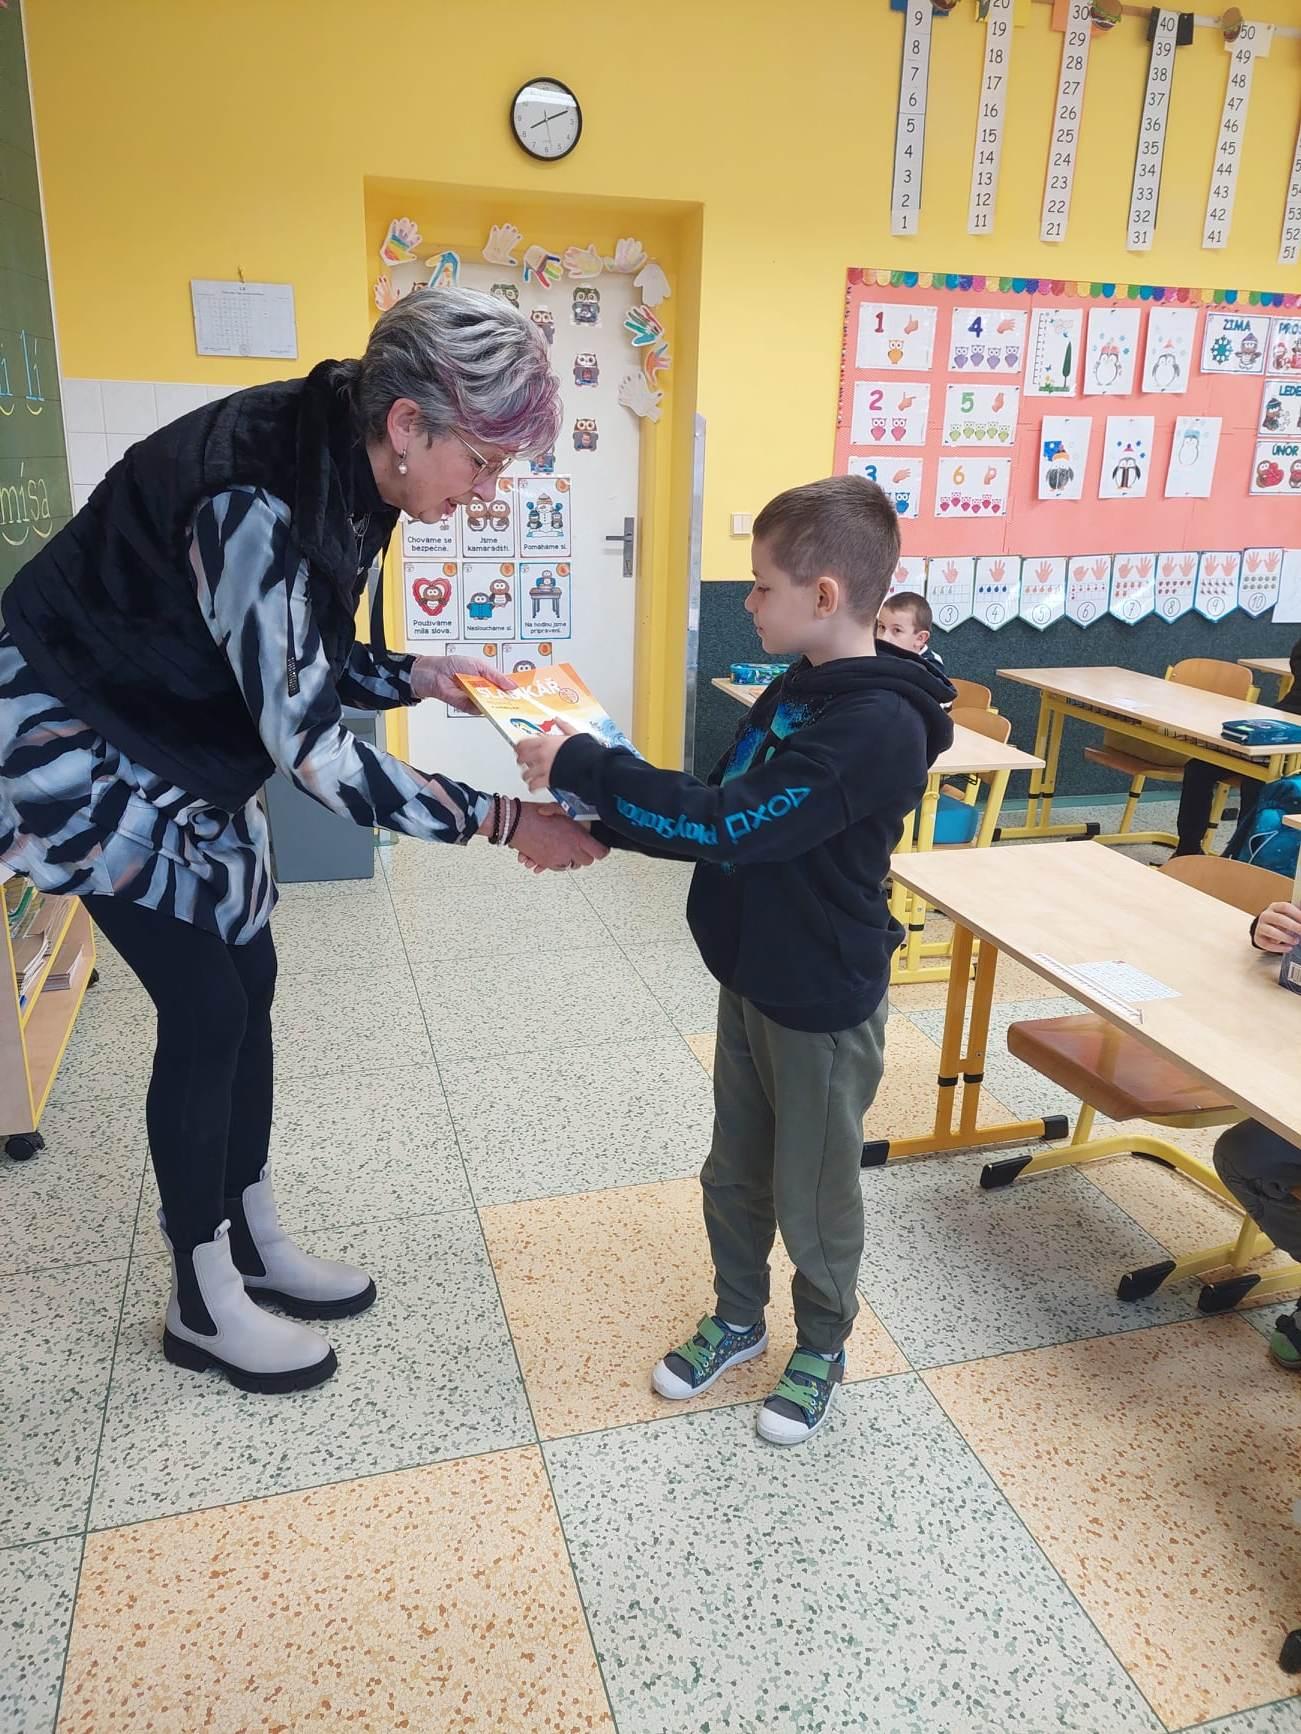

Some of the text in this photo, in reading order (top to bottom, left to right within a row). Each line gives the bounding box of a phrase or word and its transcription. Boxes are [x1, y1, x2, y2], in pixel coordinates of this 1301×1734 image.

[915, 11, 923, 25] 9
[1073, 5, 1089, 20] 30
[991, 22, 1006, 36] 19
[1160, 18, 1174, 32] 40
[1069, 32, 1085, 46] 29
[1240, 25, 1255, 40] 50
[912, 40, 920, 54] 8
[1156, 43, 1171, 56] 39
[989, 49, 1003, 63] 18
[1236, 50, 1251, 63] 49
[1066, 56, 1082, 70] 28
[911, 67, 919, 80] 7
[1152, 68, 1167, 81] 38
[986, 76, 1001, 90] 17
[1231, 75, 1246, 88] 48
[1063, 82, 1079, 95] 27
[909, 93, 917, 106] 6
[1148, 93, 1164, 106] 37
[1228, 98, 1243, 111] 47
[983, 104, 998, 117] 16
[1060, 106, 1076, 120] 26
[907, 119, 915, 132] 5
[1145, 118, 1160, 131] 36
[1224, 119, 1238, 132] 46
[982, 129, 997, 143] 15
[1057, 129, 1073, 142] 25
[905, 145, 912, 158] 4
[1142, 142, 1159, 154] 35
[1220, 142, 1235, 154] 45
[979, 151, 994, 164] 14
[1054, 153, 1071, 166] 24
[1139, 164, 1155, 176] 34
[1217, 163, 1232, 175] 44
[904, 170, 911, 183] 3
[977, 173, 992, 185] 13
[1051, 176, 1067, 189] 23
[1136, 188, 1153, 200] 33
[1213, 186, 1228, 198] 43
[901, 195, 909, 207] 2
[975, 193, 990, 206] 12
[1048, 201, 1065, 213] 22
[975, 215, 987, 227] 11
[1133, 210, 1150, 223] 32
[1210, 209, 1225, 220] 42
[902, 216, 907, 229] 1
[1046, 223, 1060, 235] 21
[1133, 232, 1147, 243] 31
[1208, 230, 1221, 242] 41
[1286, 228, 1300, 241] 52
[1282, 246, 1296, 259] 51
[875, 312, 884, 332] 1
[968, 316, 983, 338] 4
[1223, 319, 1251, 332] ZIMA
[1279, 322, 1301, 335] PRO
[869, 390, 884, 411] 2
[961, 392, 974, 413] 5
[953, 465, 966, 485] 6
